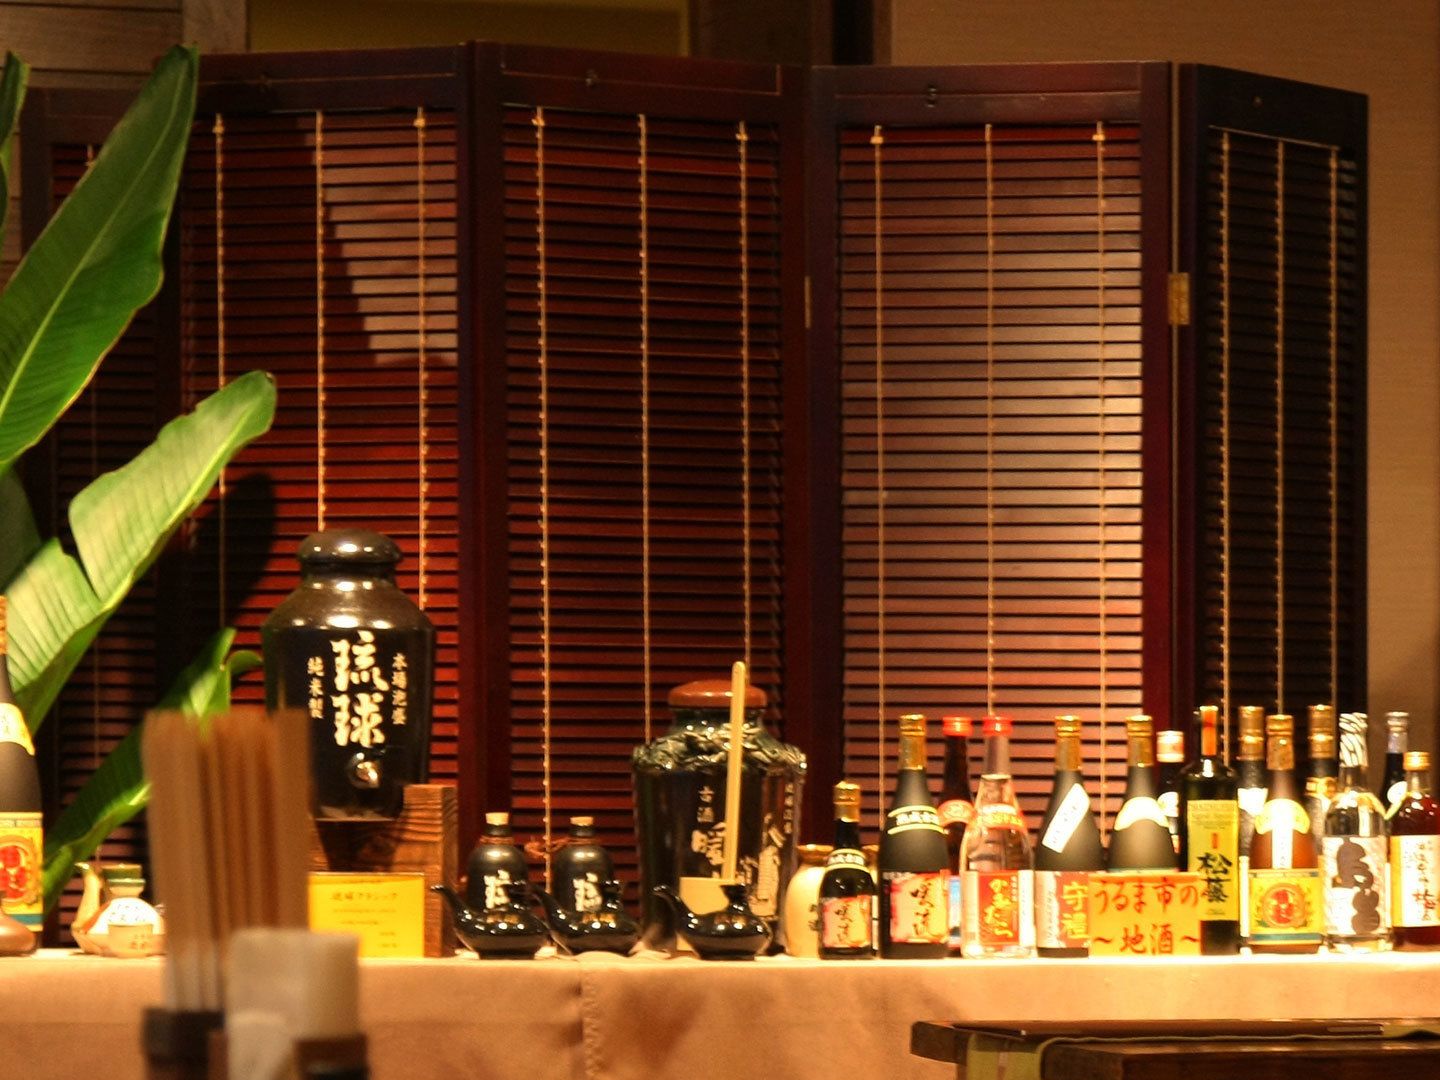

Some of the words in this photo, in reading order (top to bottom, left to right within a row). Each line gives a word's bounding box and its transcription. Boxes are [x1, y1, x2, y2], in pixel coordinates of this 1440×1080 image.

[330, 630, 390, 748] 琉球
[1094, 876, 1199, 914] うるま市の
